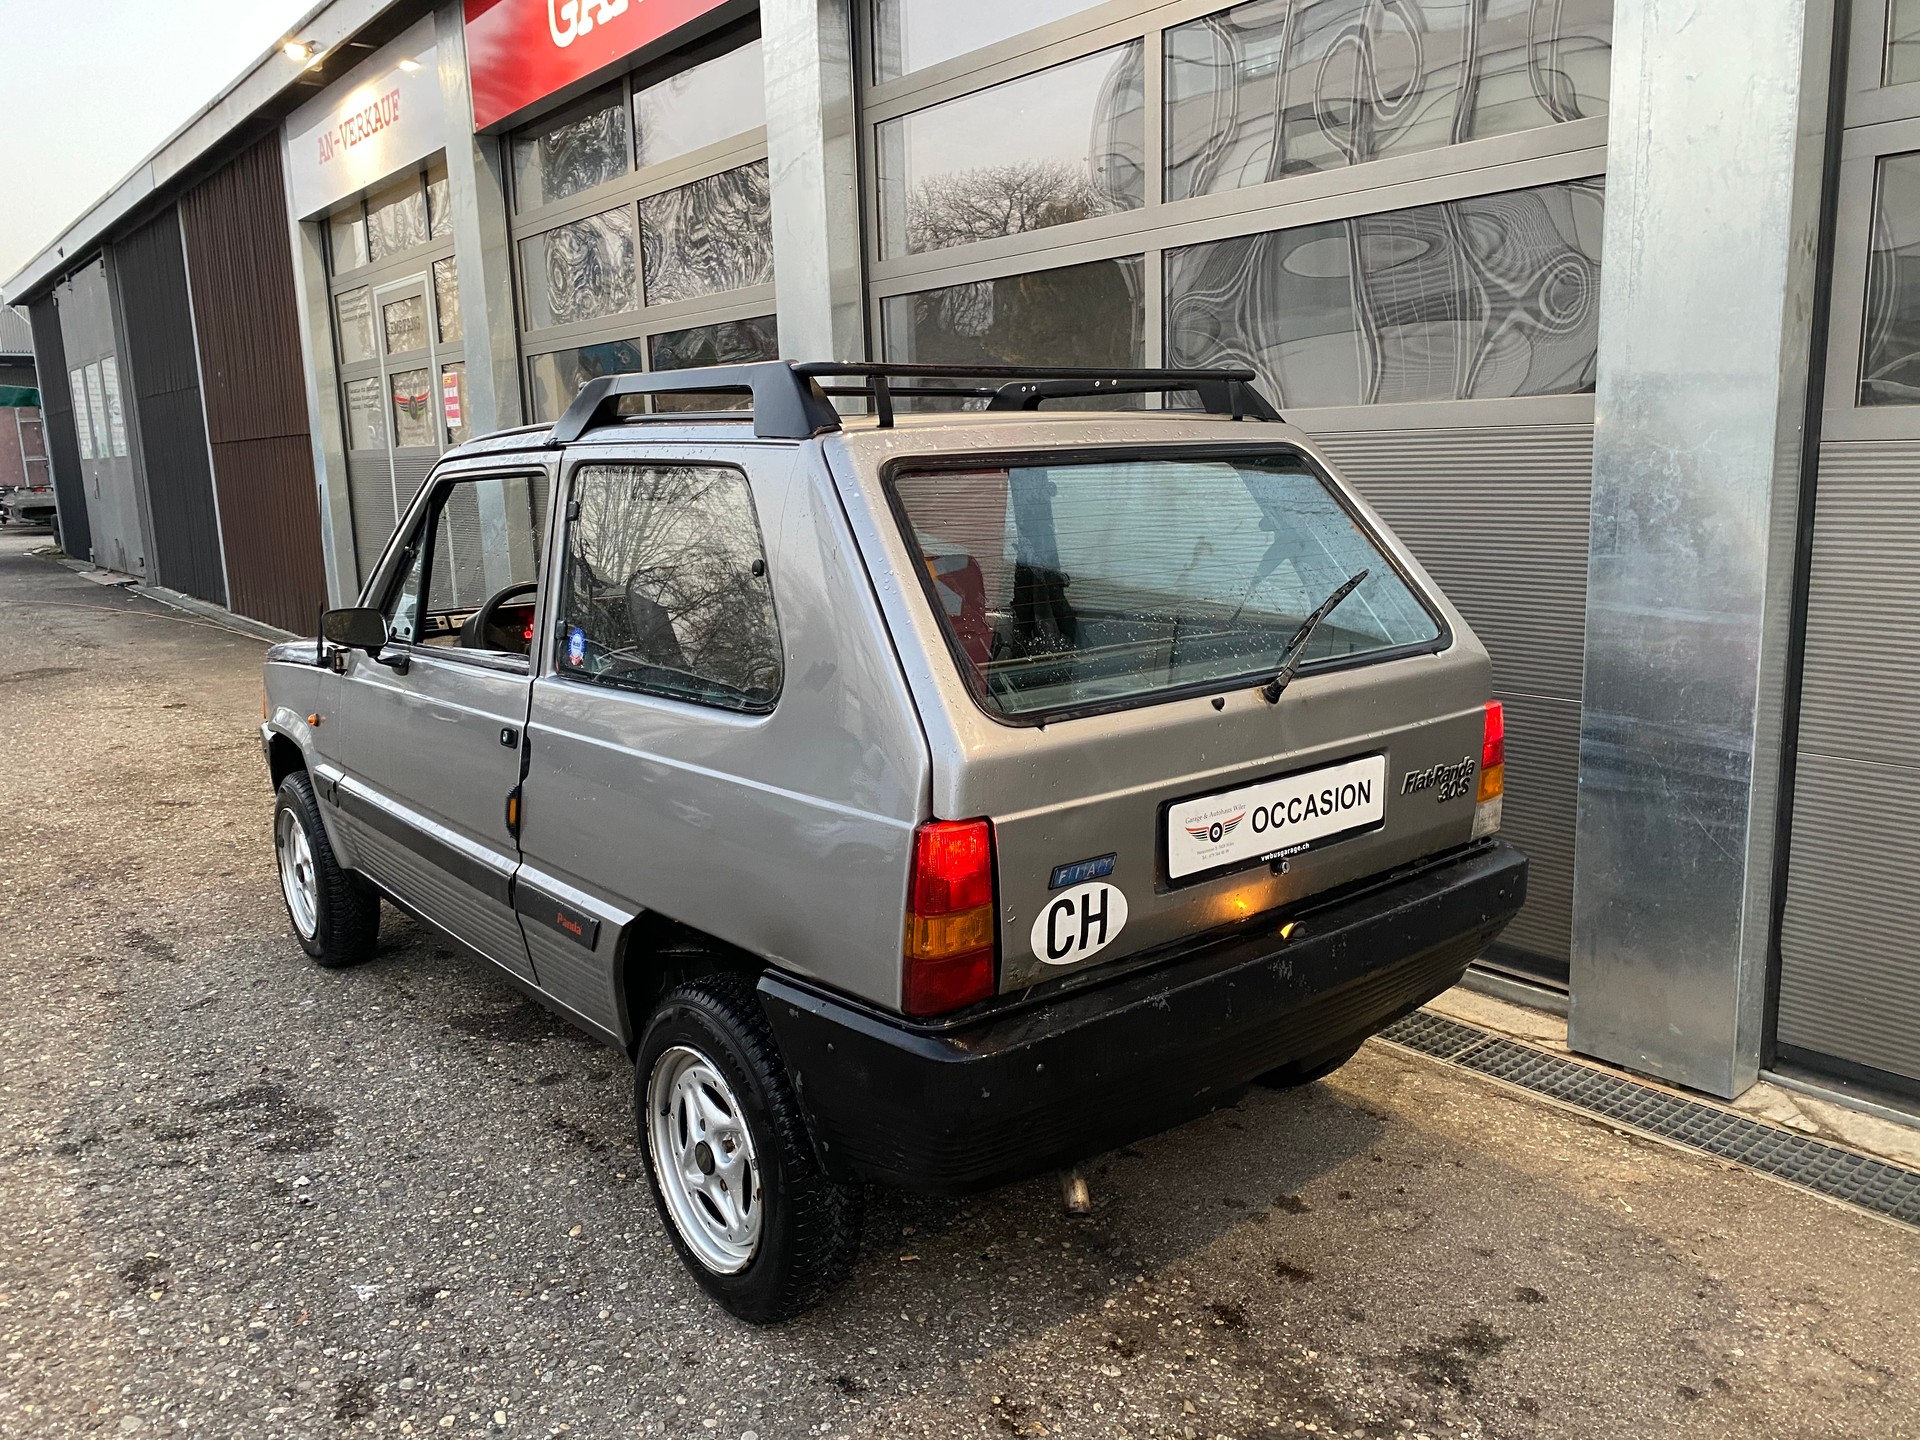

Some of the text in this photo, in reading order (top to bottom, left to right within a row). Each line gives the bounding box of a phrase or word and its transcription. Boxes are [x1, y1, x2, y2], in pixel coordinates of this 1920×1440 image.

[318, 88, 400, 165] AN-VERKAUF
[1185, 803, 1246, 825] Garage & Autohaus Wiler
[1252, 779, 1371, 833] OCCASION
[1261, 843, 1310, 862] vwbusgarage.ch
[1058, 858, 1113, 884] FIAT
[557, 912, 582, 936] Panda
[1047, 888, 1108, 960] CH
